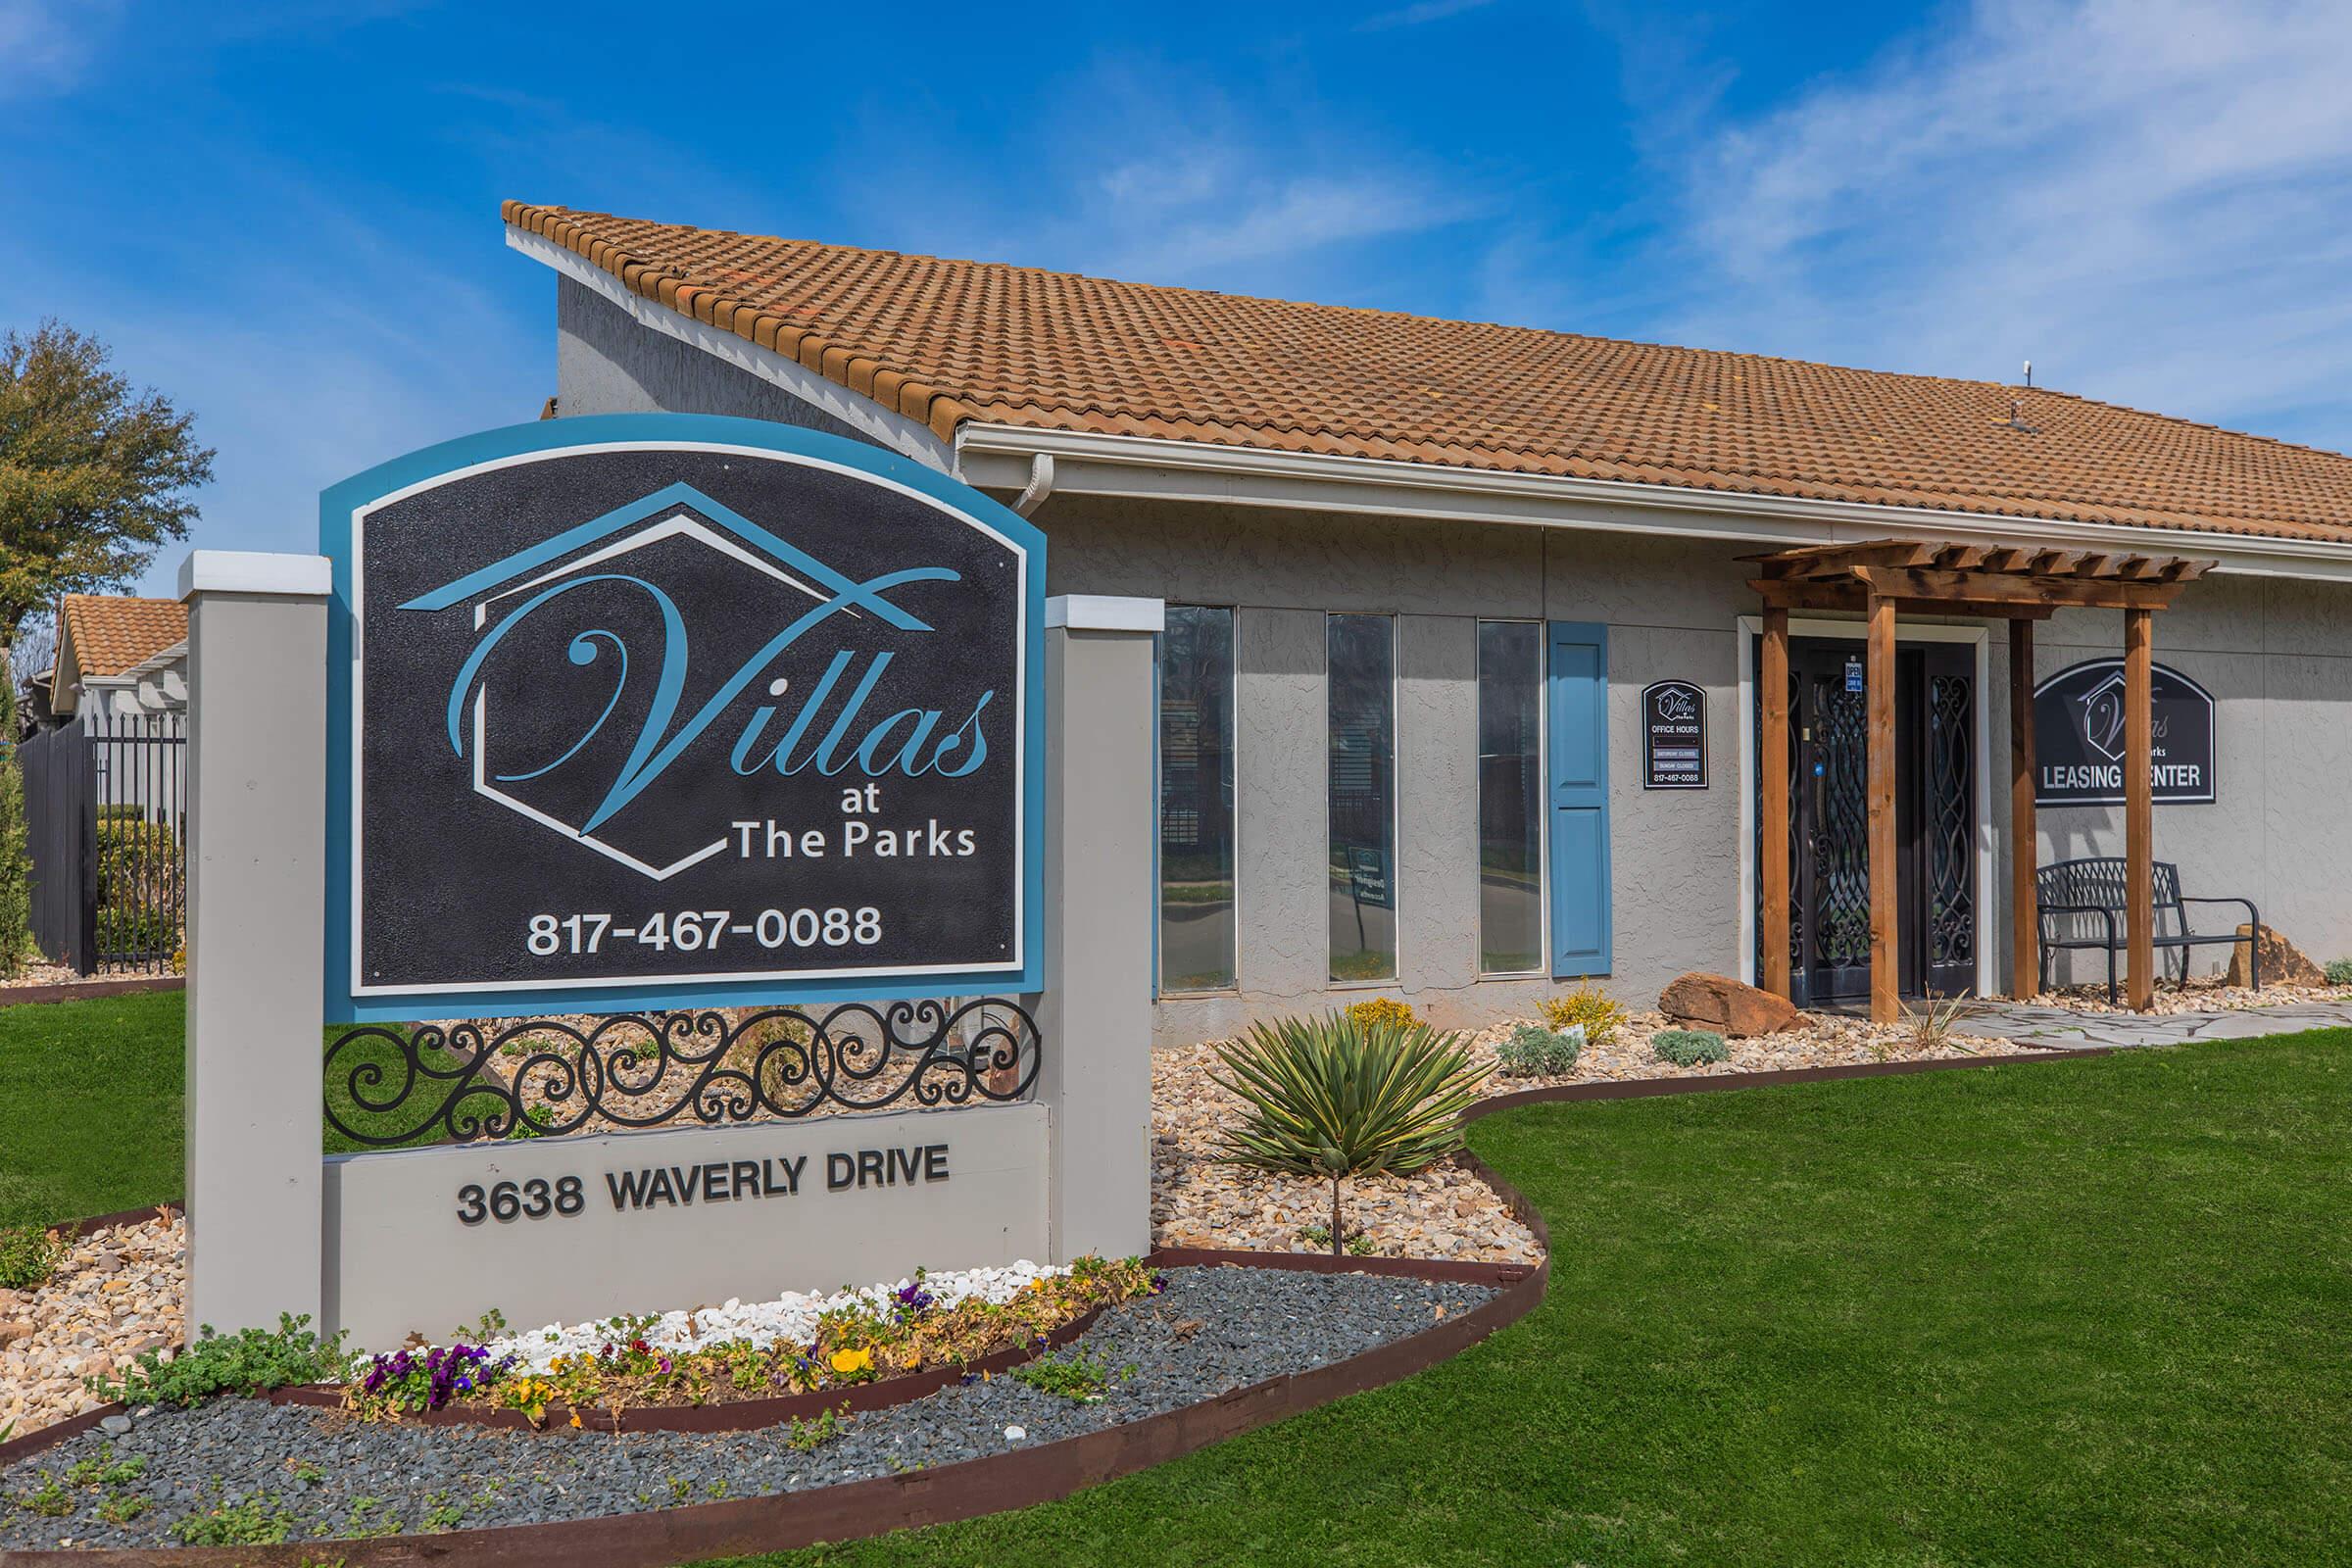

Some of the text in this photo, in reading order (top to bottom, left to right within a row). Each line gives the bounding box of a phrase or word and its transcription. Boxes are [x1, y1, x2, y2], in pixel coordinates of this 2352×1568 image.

[1847, 666, 1861, 676] OPEN
[446, 567, 994, 837] Villas
[1658, 693, 1695, 715] Villas
[1651, 725, 1699, 735] OFFICE HOURS
[2043, 764, 2201, 789] LEASING NTER
[840, 782, 880, 815] at
[732, 818, 978, 859] The Parks
[526, 906, 883, 957] 817-467-0088
[457, 1144, 950, 1227] 3638 WAVERLY DRIVE
